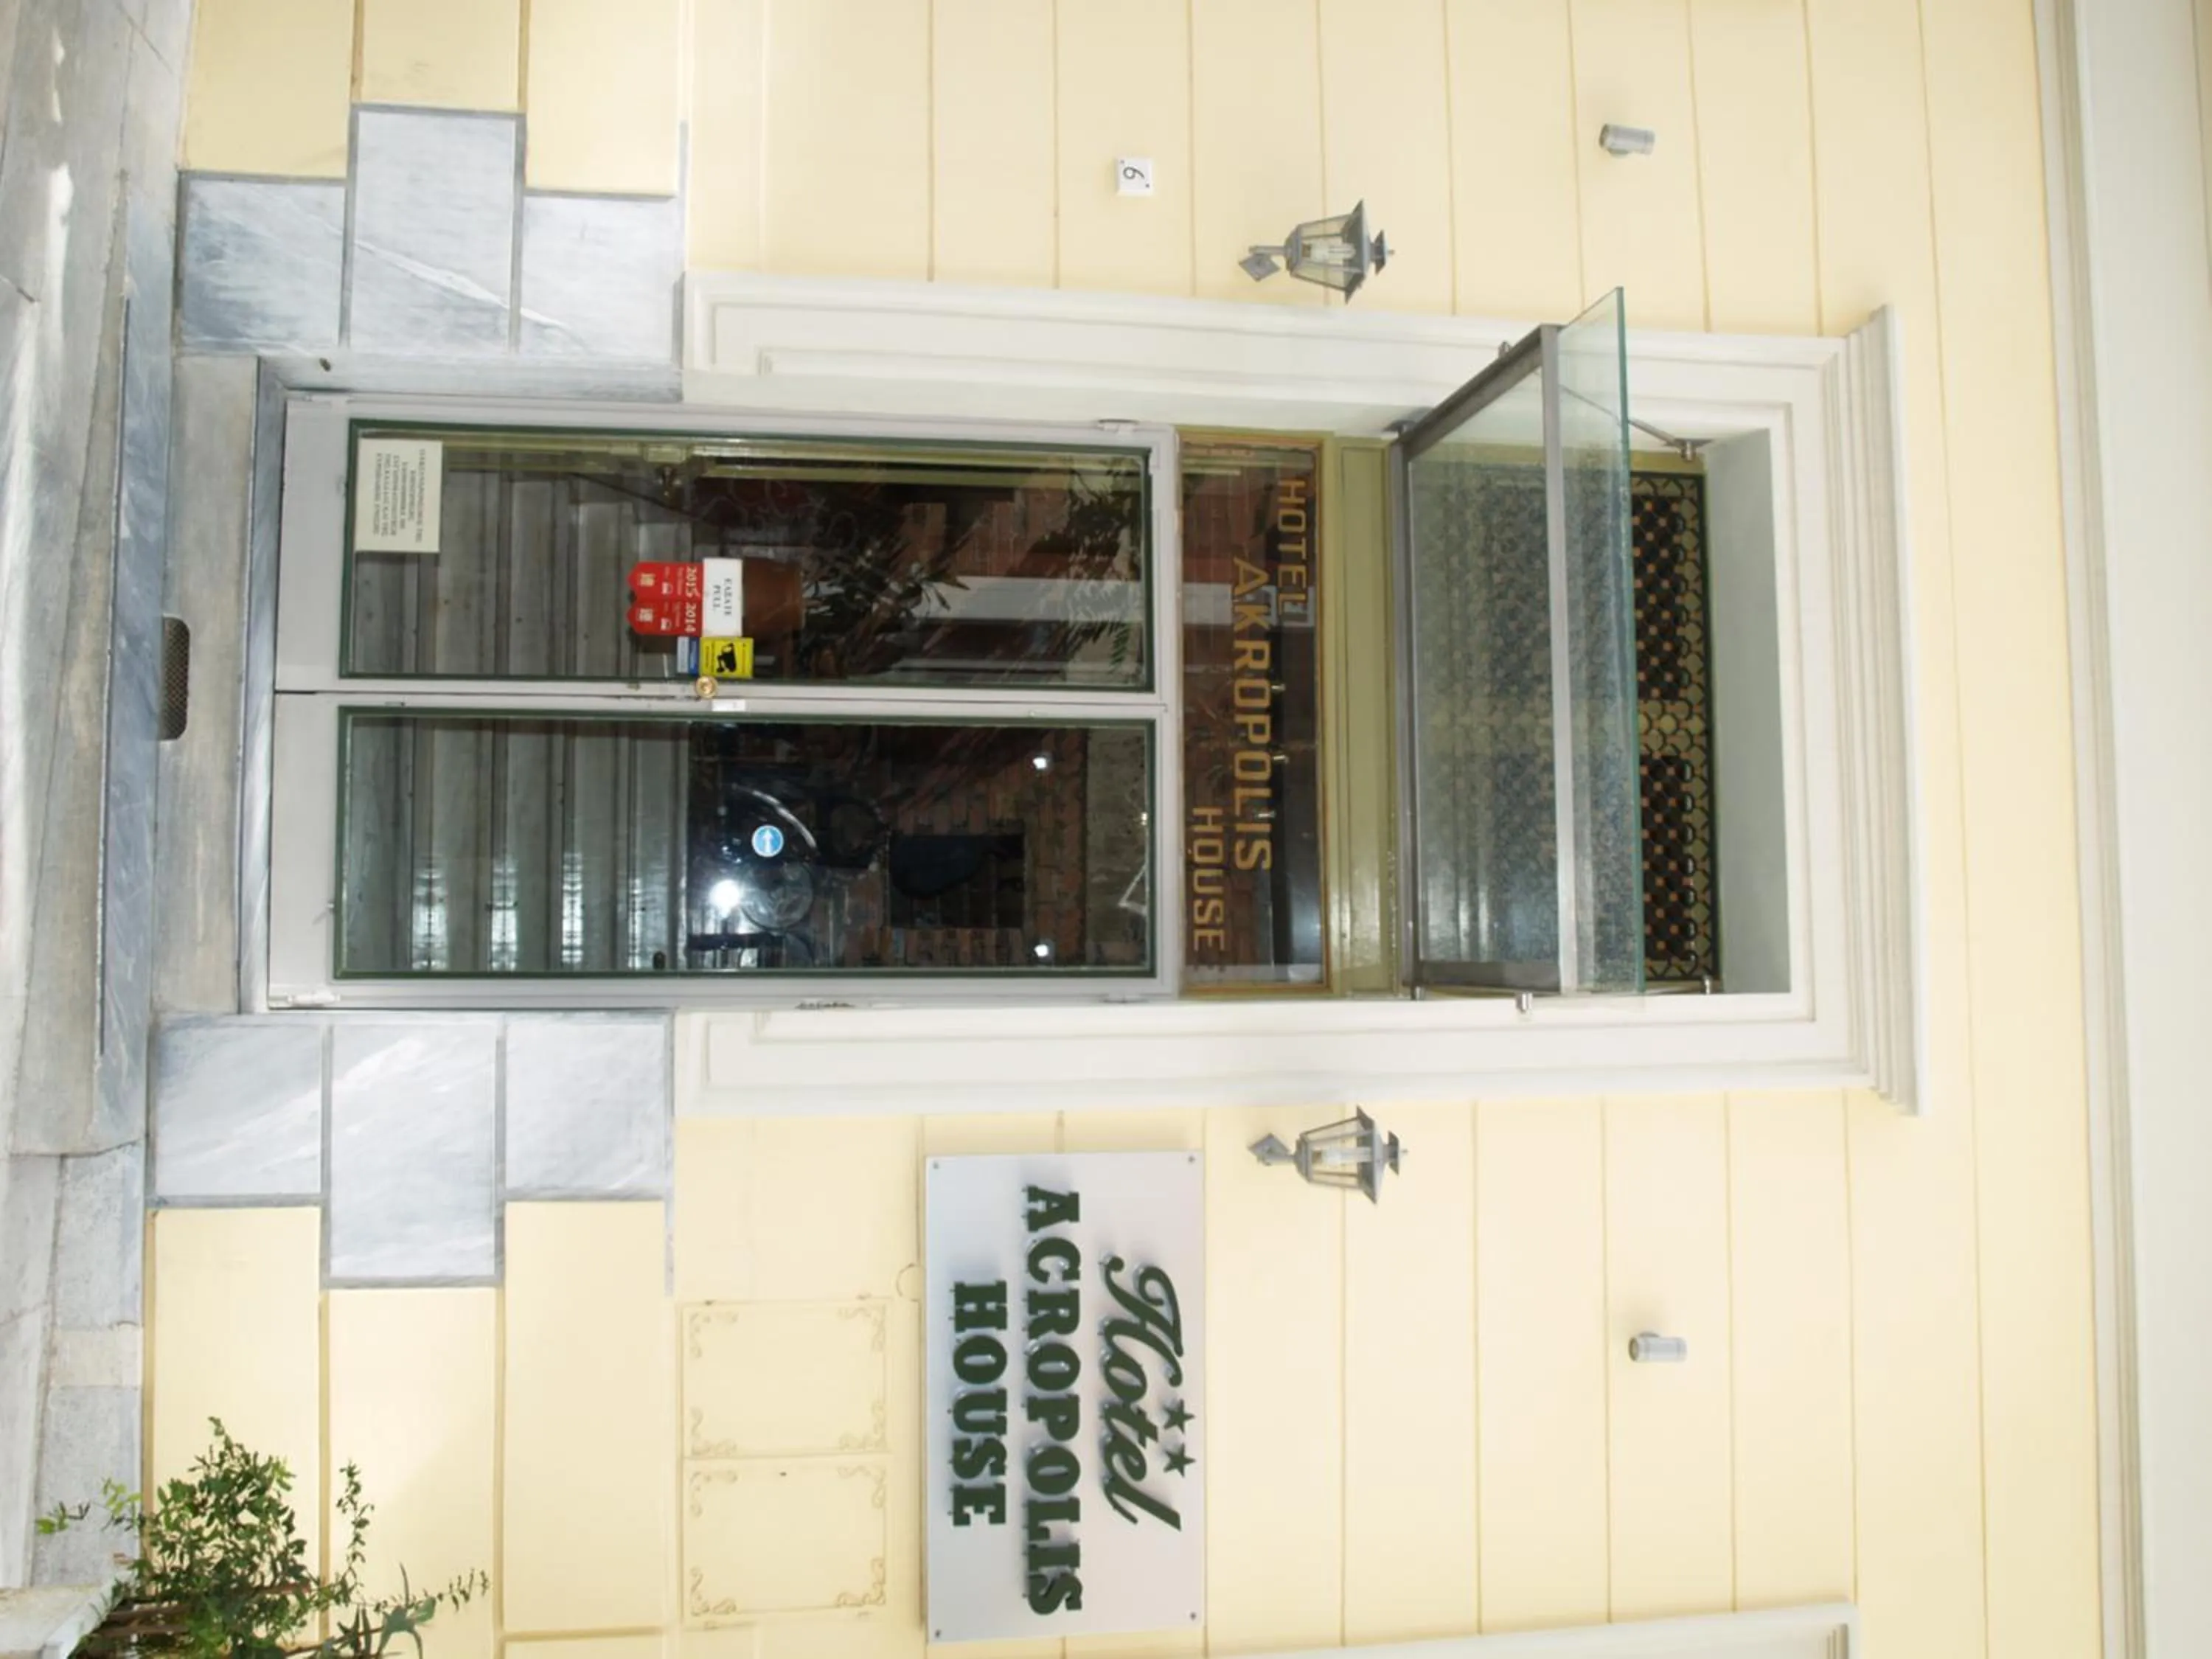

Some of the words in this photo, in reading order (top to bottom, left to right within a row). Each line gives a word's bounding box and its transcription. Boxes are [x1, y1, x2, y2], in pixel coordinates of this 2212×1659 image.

[1122, 167, 1145, 180] 6
[684, 602, 697, 633] 2014
[685, 566, 698, 598] 2015
[1277, 479, 1307, 615] HOTEL
[1233, 557, 1273, 871] AKROPOLIS
[1192, 807, 1225, 952] HOUSE
[952, 1279, 1008, 1527] HOUSE
[1025, 1184, 1083, 1615] ACROPOLIS
[1102, 1254, 1183, 1531] Hotel
